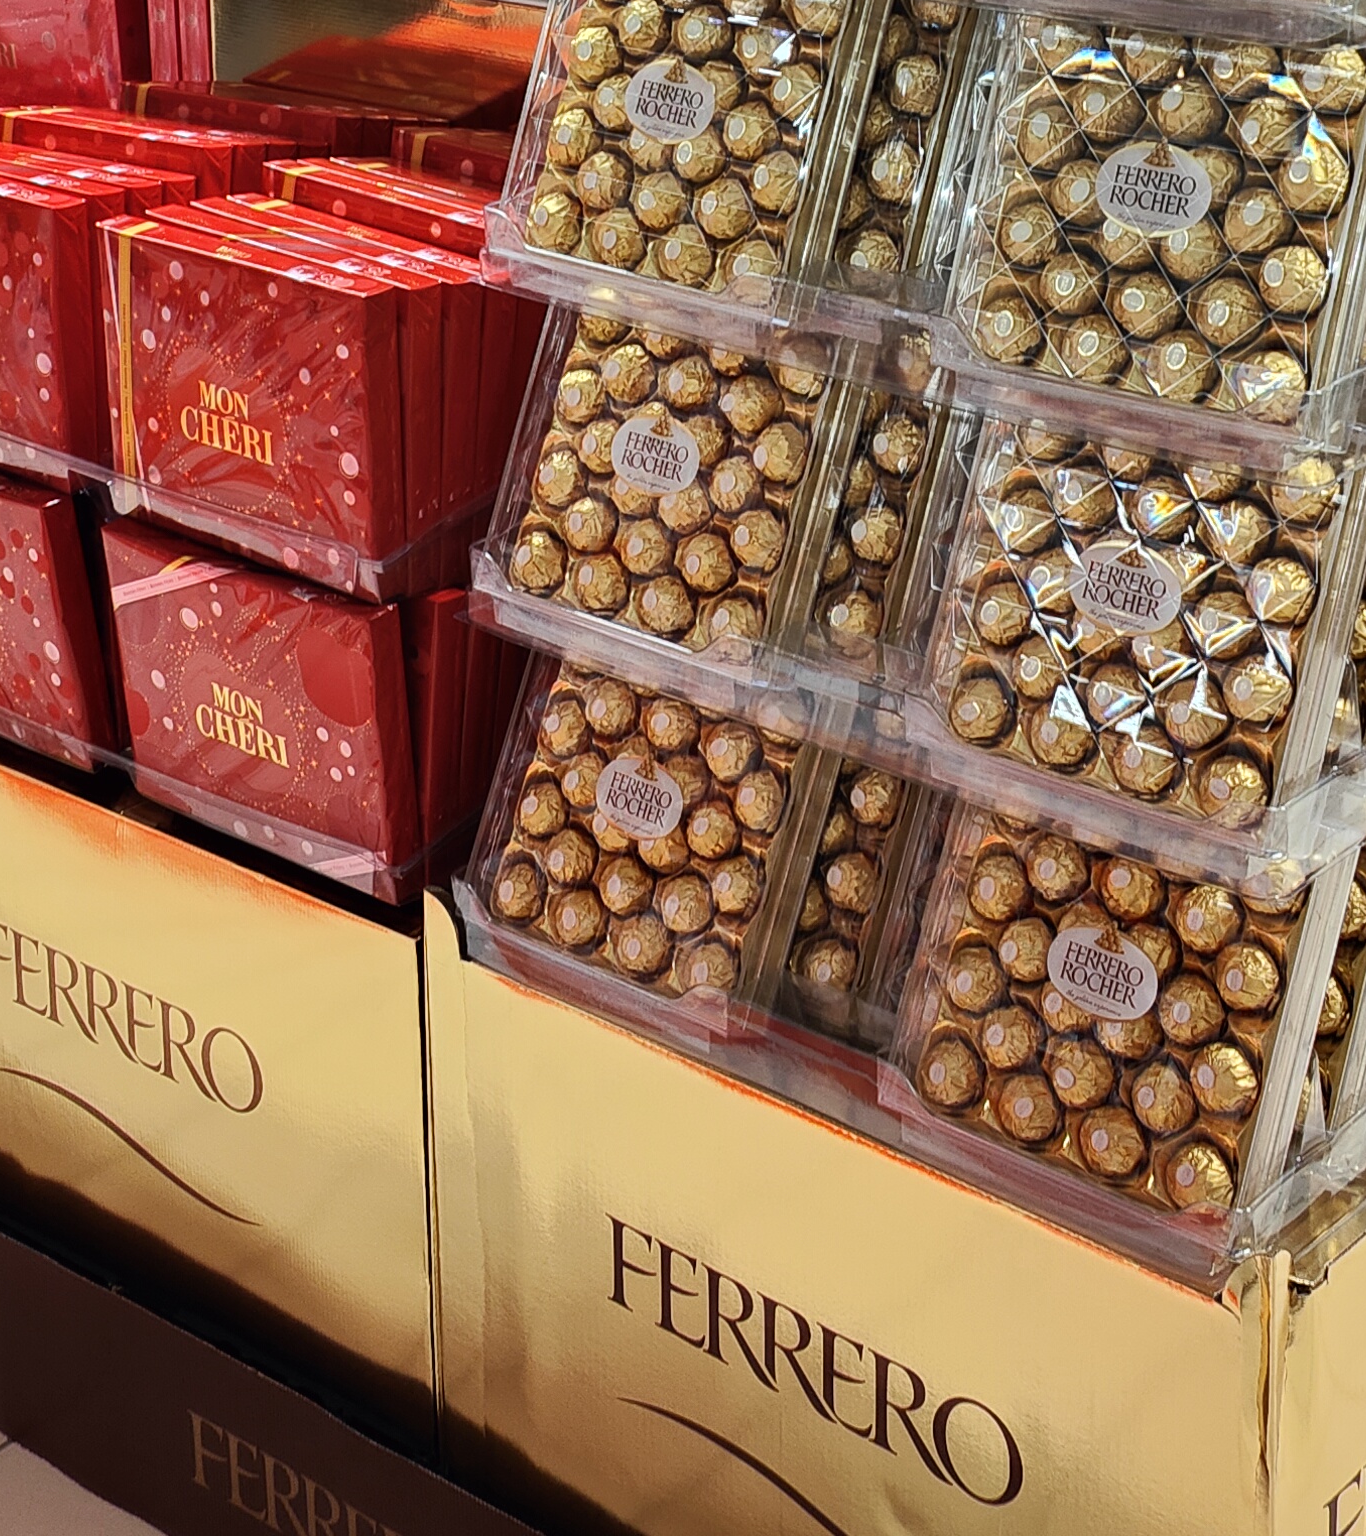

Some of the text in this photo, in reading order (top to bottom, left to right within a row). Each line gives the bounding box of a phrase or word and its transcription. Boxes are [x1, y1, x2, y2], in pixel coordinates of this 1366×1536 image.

[639, 79, 704, 107] FERRERO
[634, 97, 699, 129] ROCHER
[1114, 163, 1197, 195] FERRERO
[1108, 186, 1190, 217] ROCHER
[197, 379, 251, 419] MON
[179, 408, 274, 467] CHÉRI
[625, 429, 689, 465] FERRERO
[620, 447, 684, 483] ROCHER
[1087, 560, 1167, 597] FERRERO
[1081, 581, 1161, 622] ROCHER
[211, 682, 264, 725] MON
[195, 708, 289, 769] CHÉRI
[605, 789, 666, 826] ROCHER
[611, 770, 673, 809] FERRERO
[1064, 940, 1144, 986] FERRERO
[1059, 962, 1137, 1009] ROCHER
[605, 1213, 1025, 1506] FERRERO
